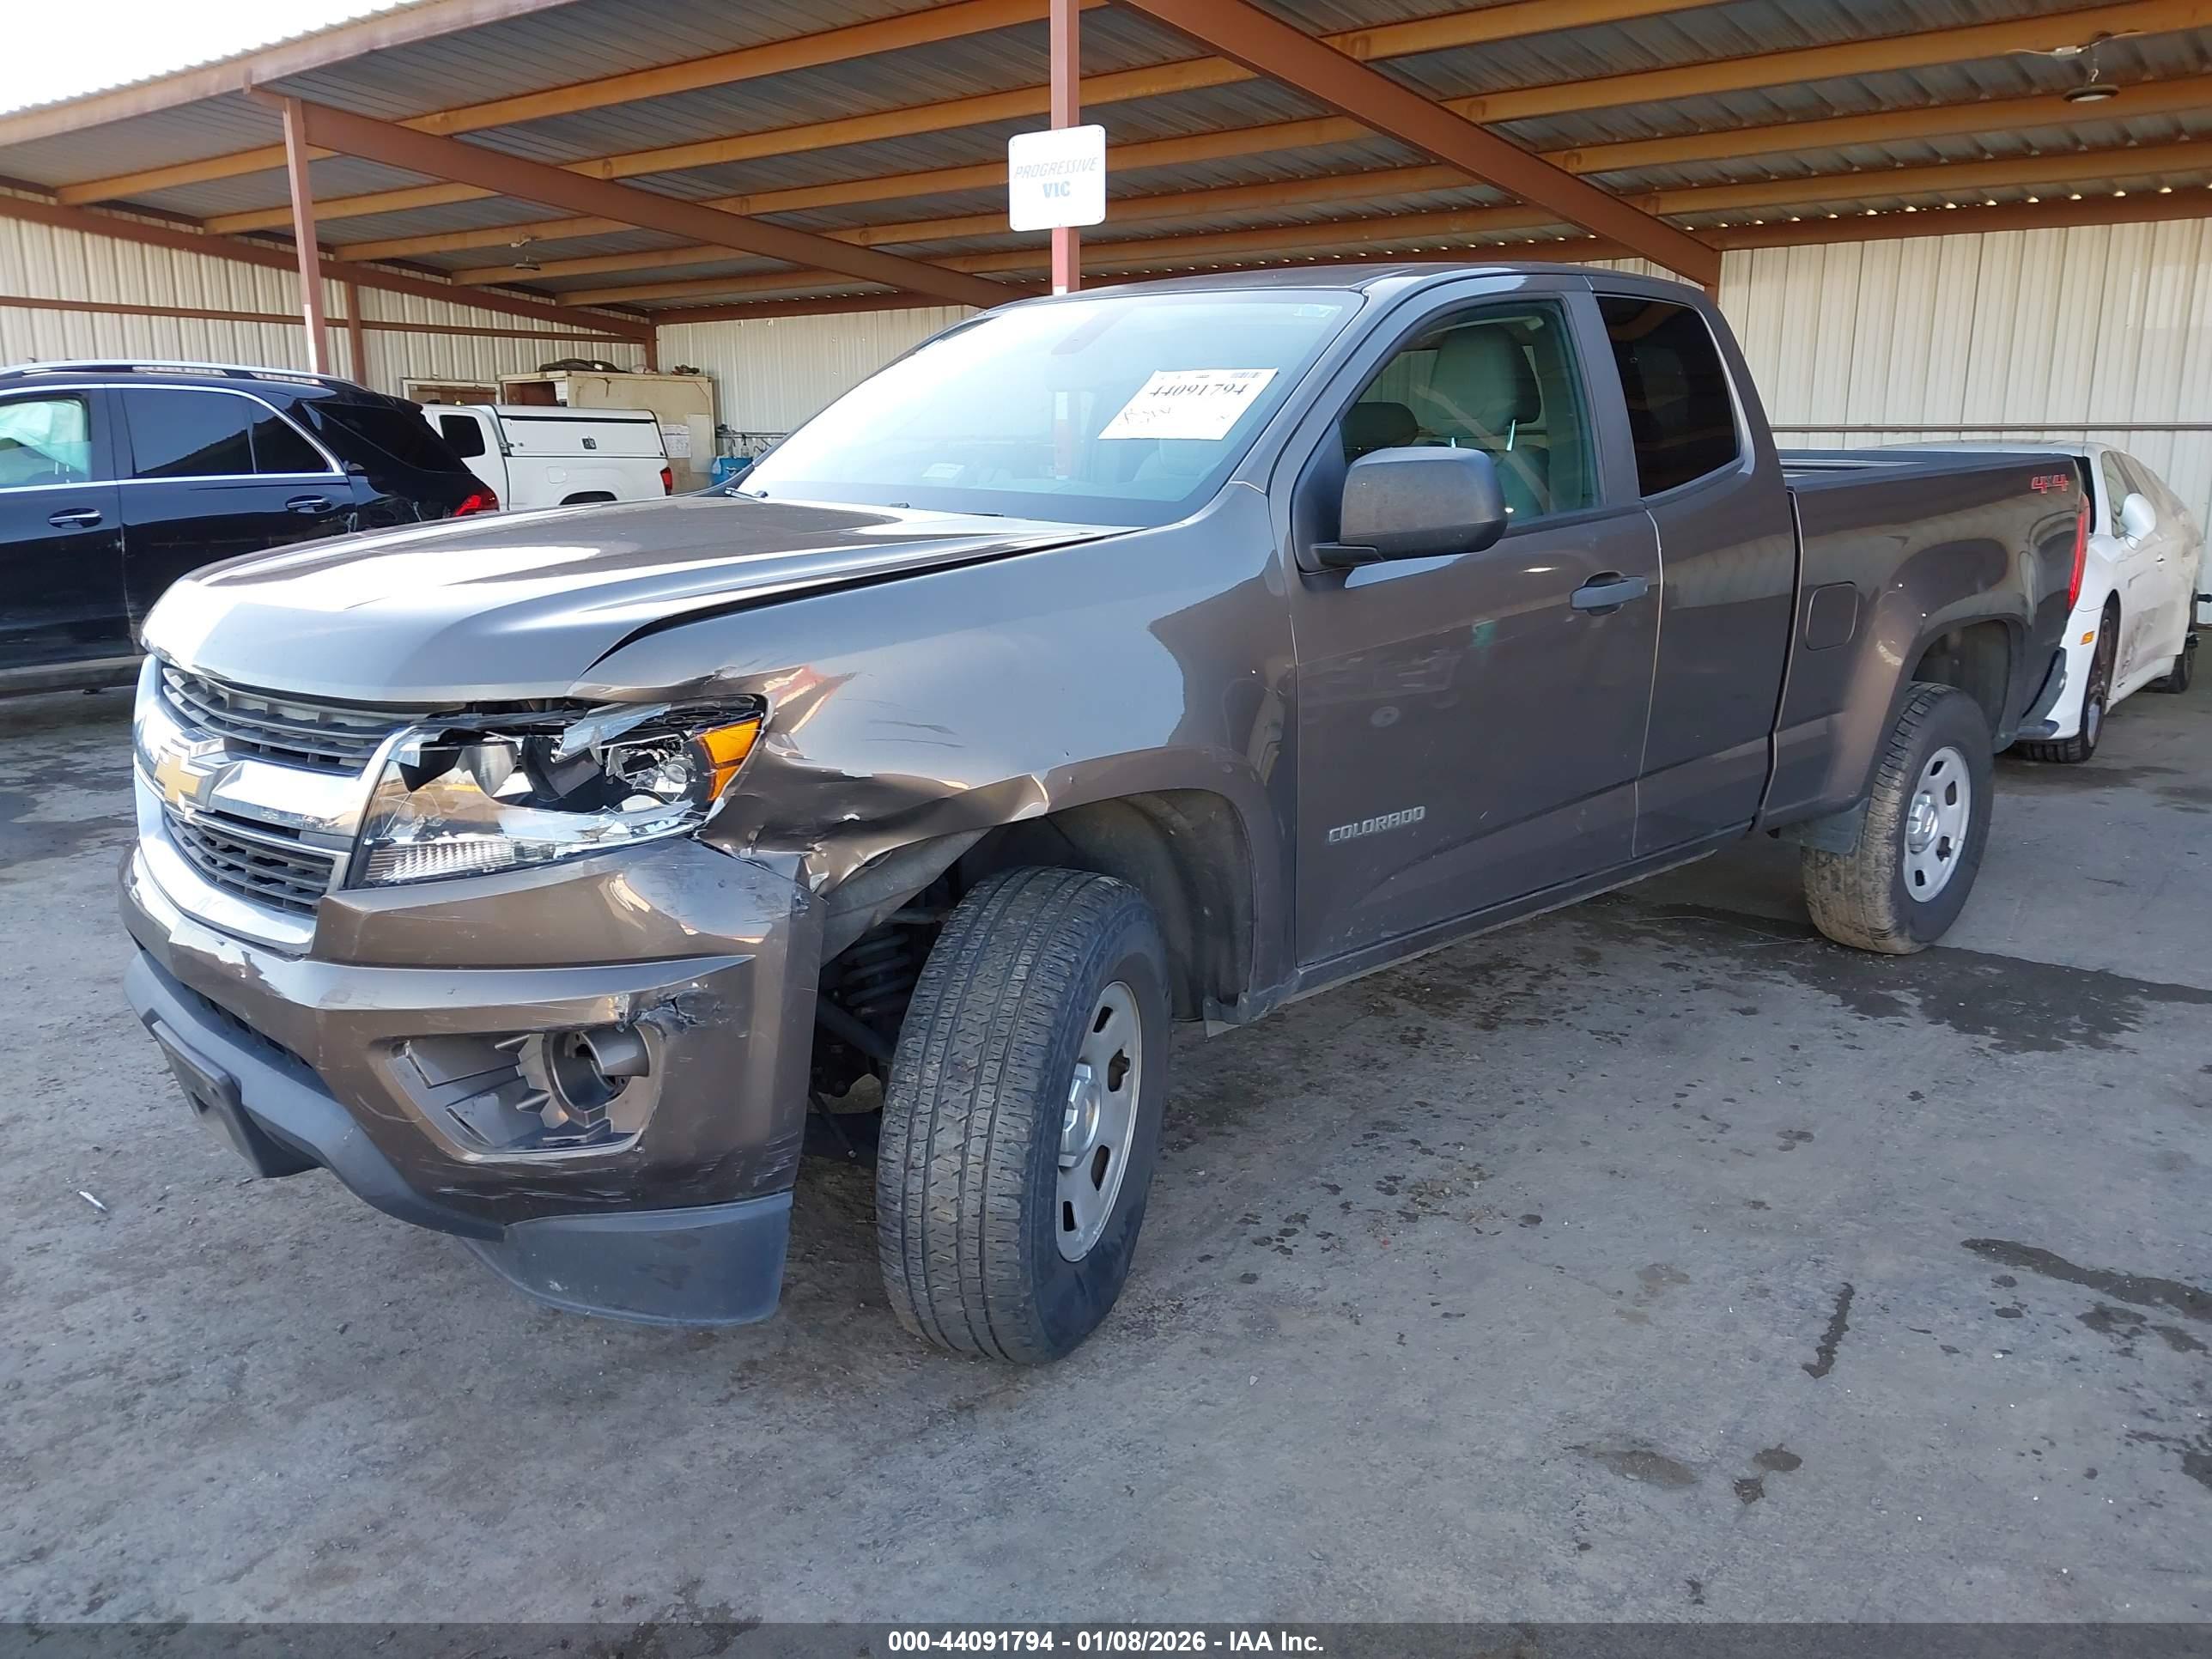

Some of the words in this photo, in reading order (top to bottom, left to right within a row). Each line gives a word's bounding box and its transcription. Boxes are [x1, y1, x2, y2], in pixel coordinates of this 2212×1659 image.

[1013, 157, 1099, 179] PROGRESSIVE
[1042, 180, 1071, 199] VIC
[1148, 383, 1249, 398] 44091794
[1328, 805, 1425, 844] COLORADO
